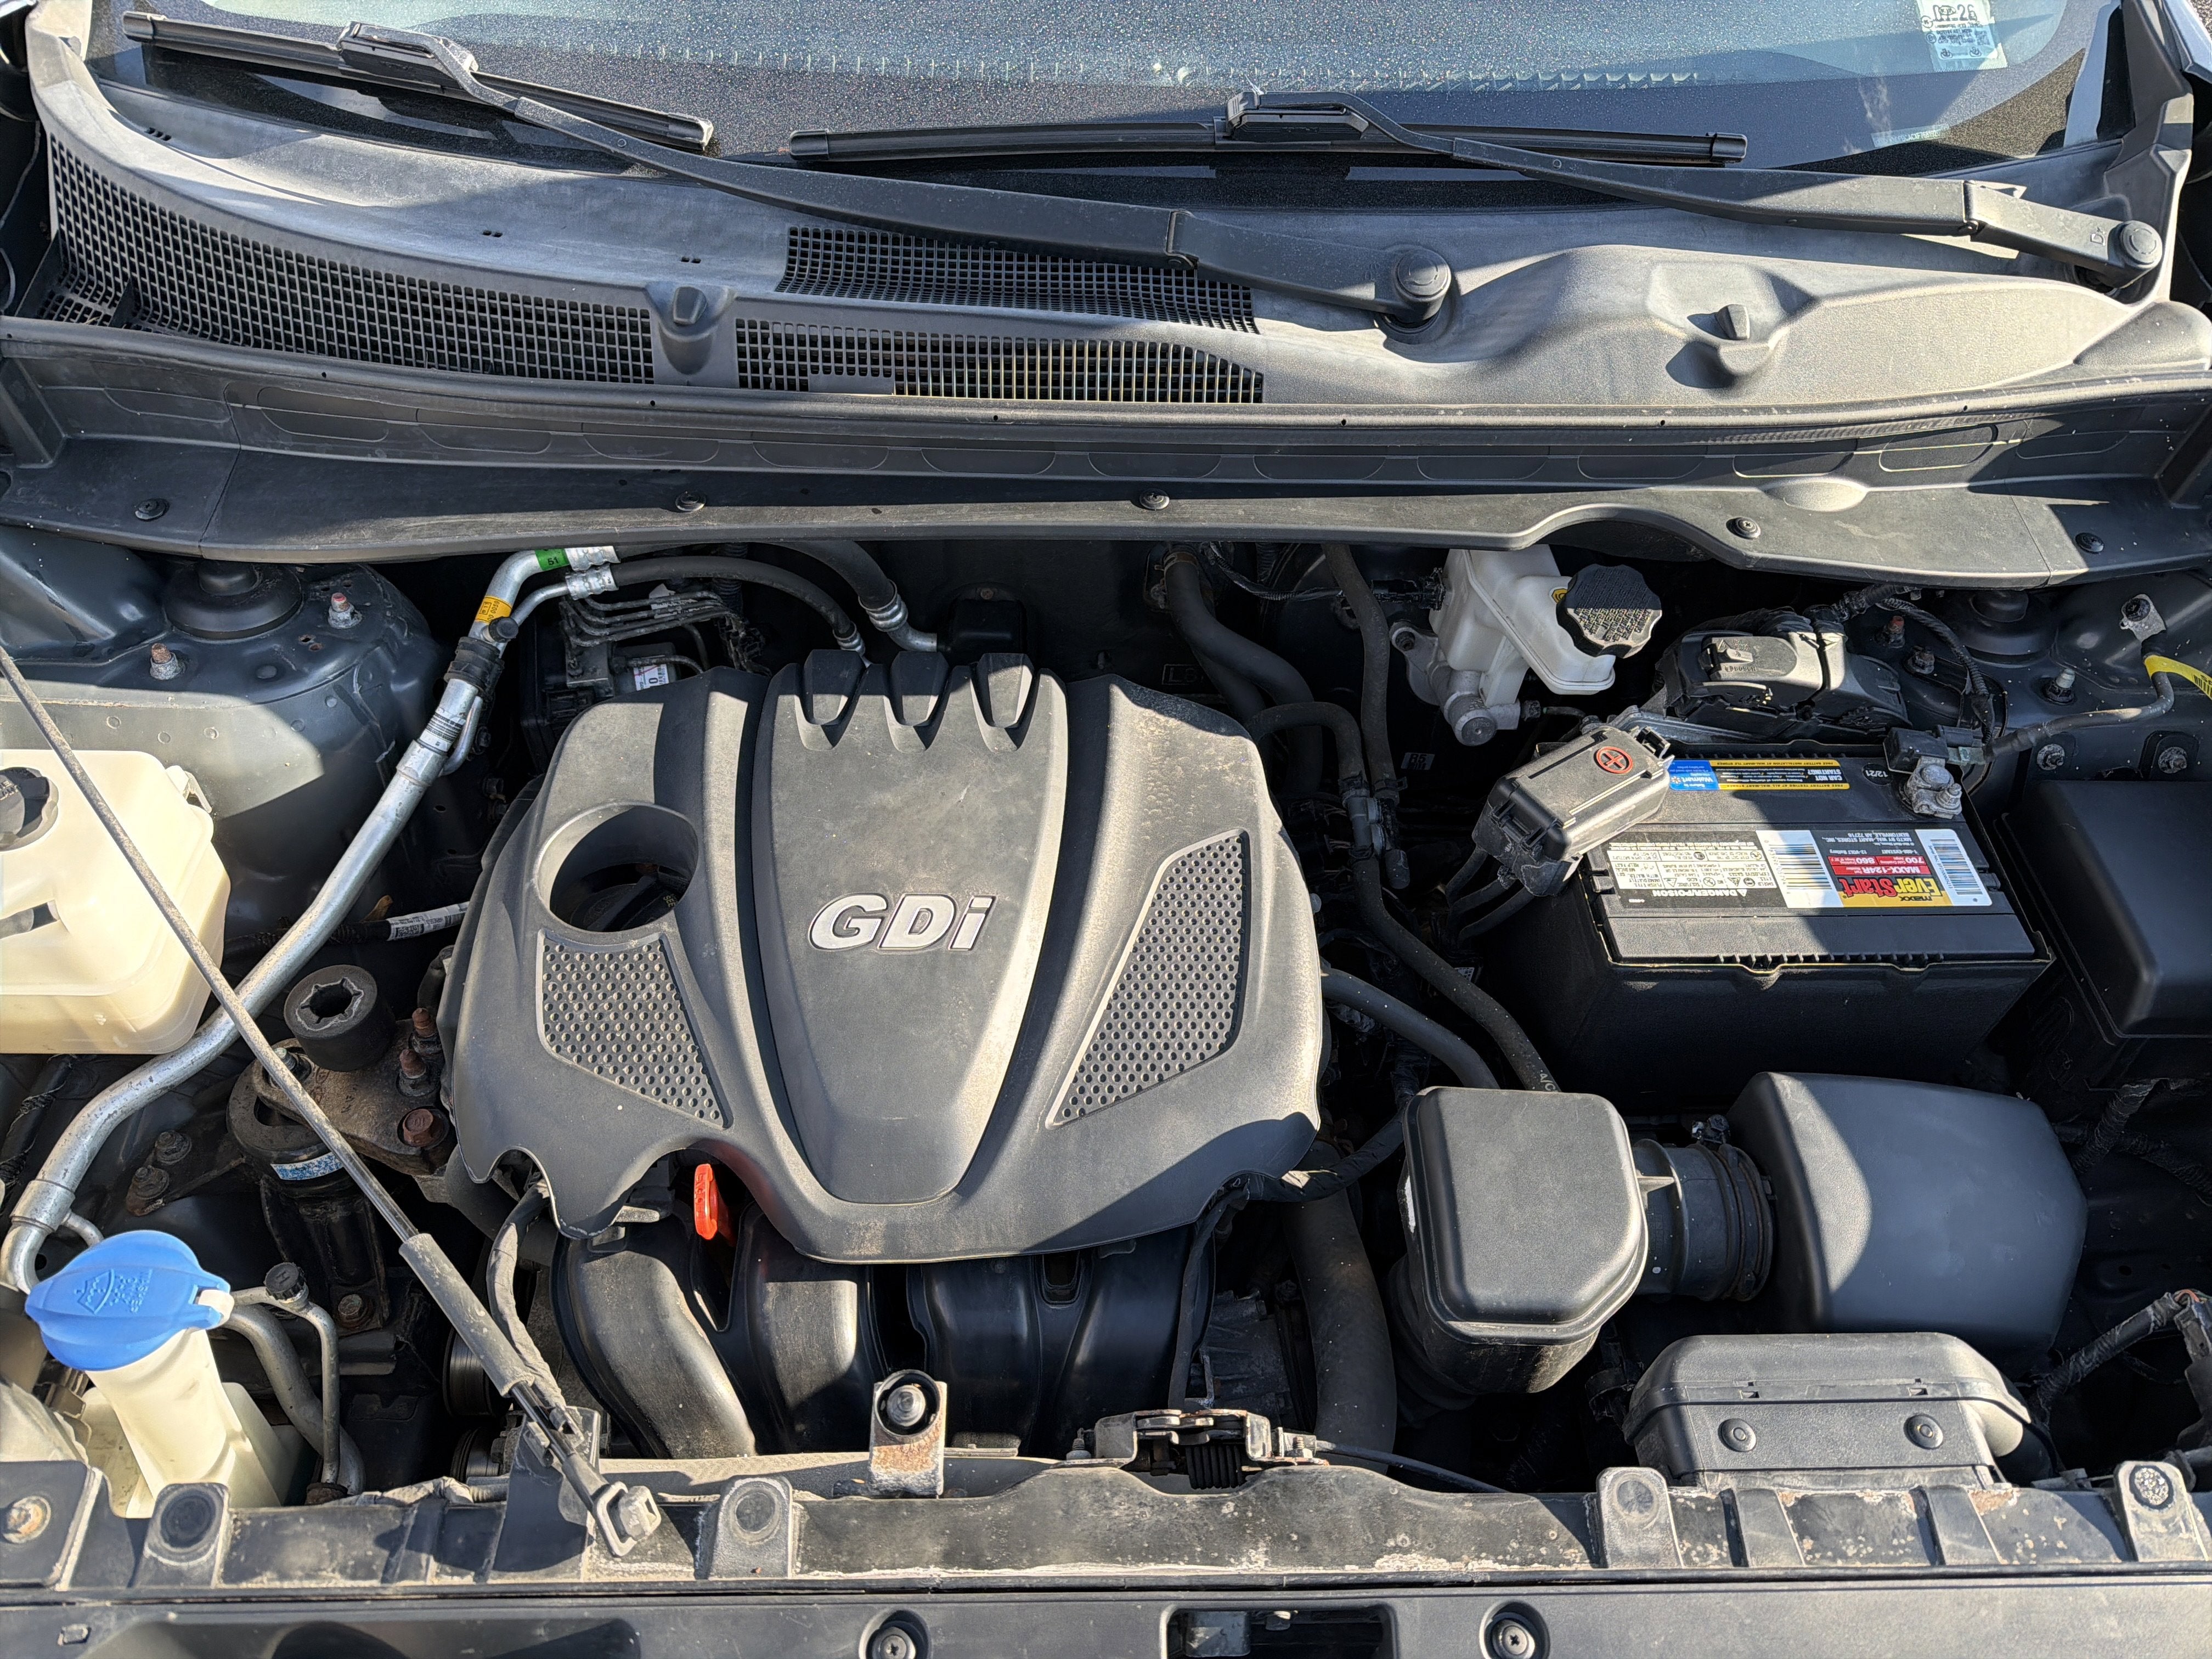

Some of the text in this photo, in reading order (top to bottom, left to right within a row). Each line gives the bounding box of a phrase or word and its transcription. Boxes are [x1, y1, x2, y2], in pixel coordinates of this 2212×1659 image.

[548, 556, 559, 566] 51
[1837, 877, 1942, 898] EverStart
[809, 893, 996, 951] GDi
